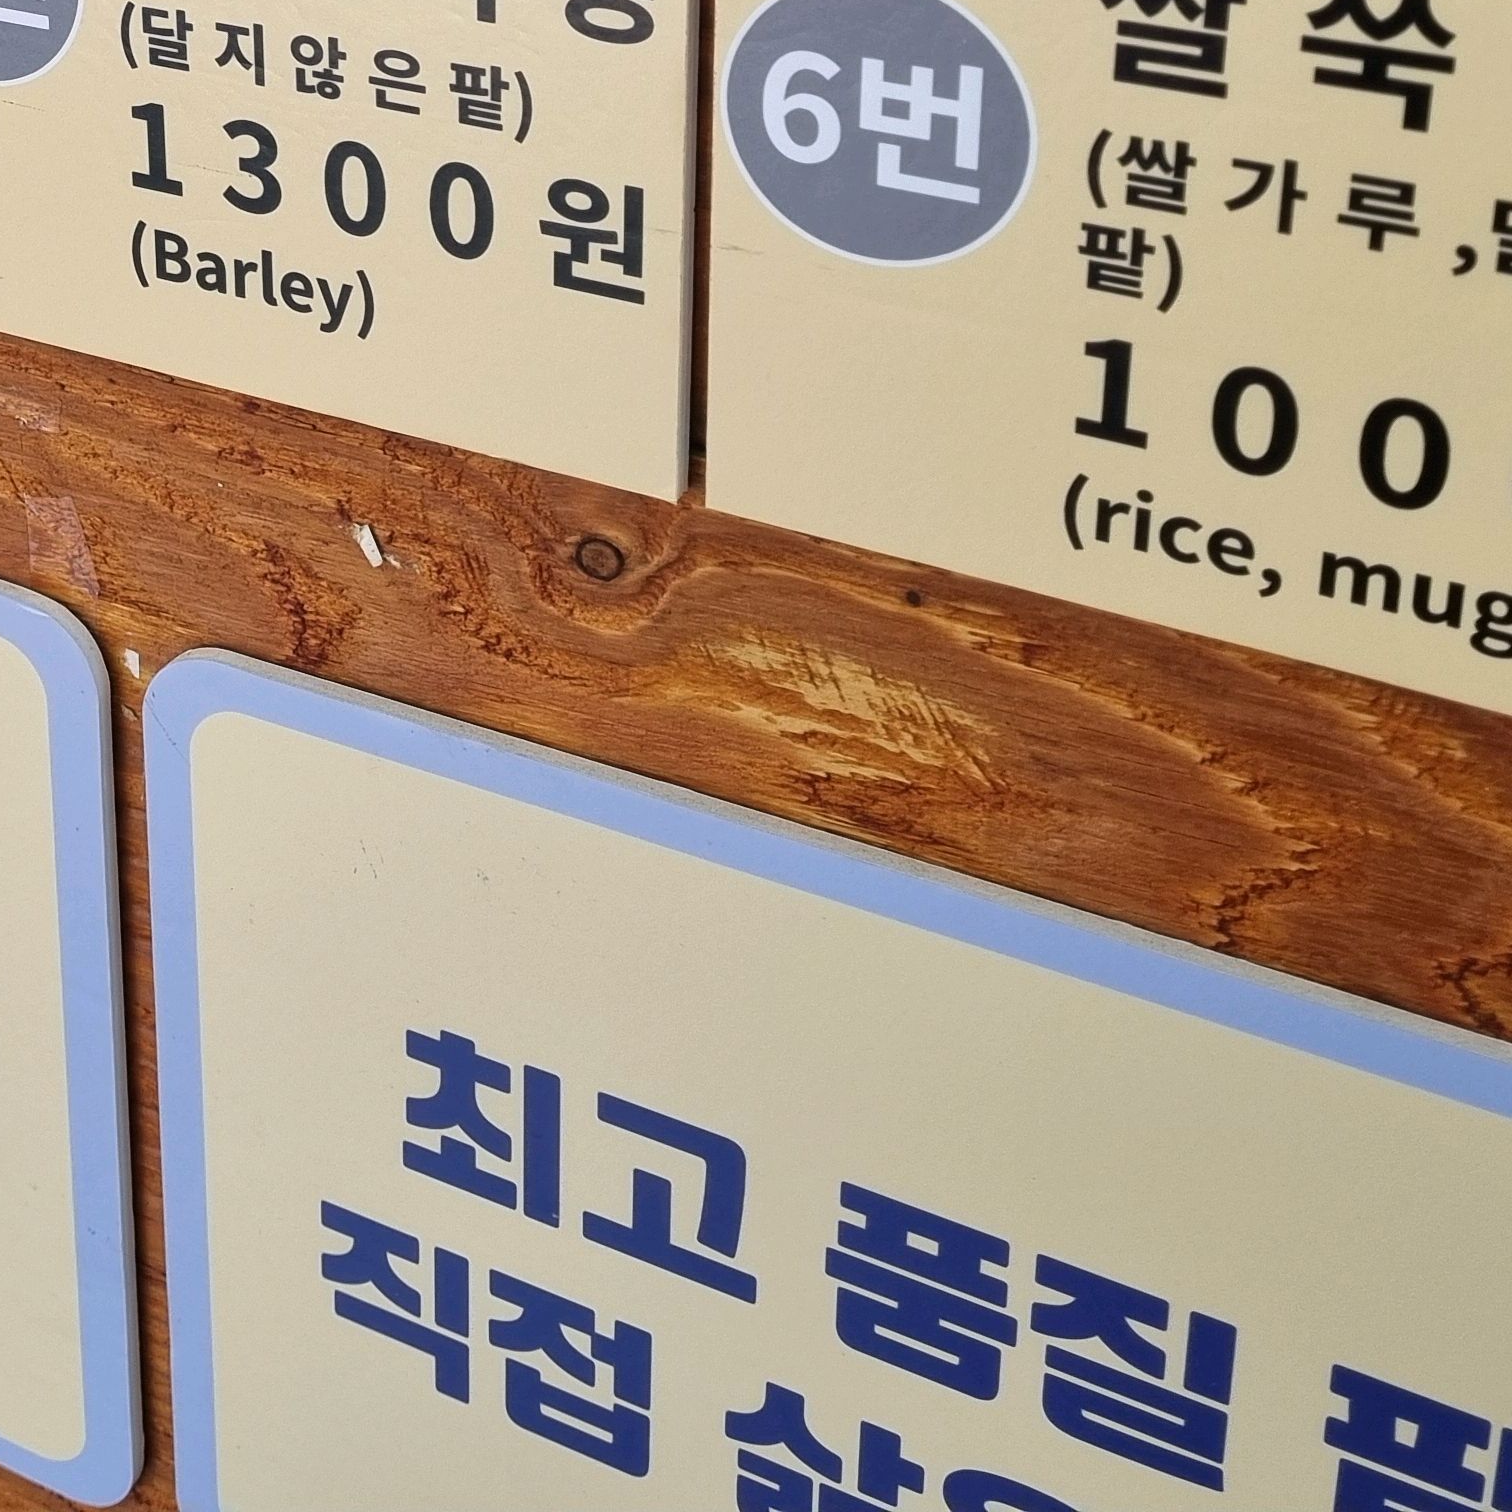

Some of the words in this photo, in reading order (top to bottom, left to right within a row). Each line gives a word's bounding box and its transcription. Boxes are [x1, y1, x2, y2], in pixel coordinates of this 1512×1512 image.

[761, 49, 985, 205] 6번
[130, 219, 376, 341] (Barley)
[1076, 221, 1185, 313] 팥)
[1063, 472, 1283, 599] (rice,
[402, 1028, 758, 1305] 최고
[824, 1180, 1238, 1492] 품질
[319, 1198, 653, 1478] 직접
